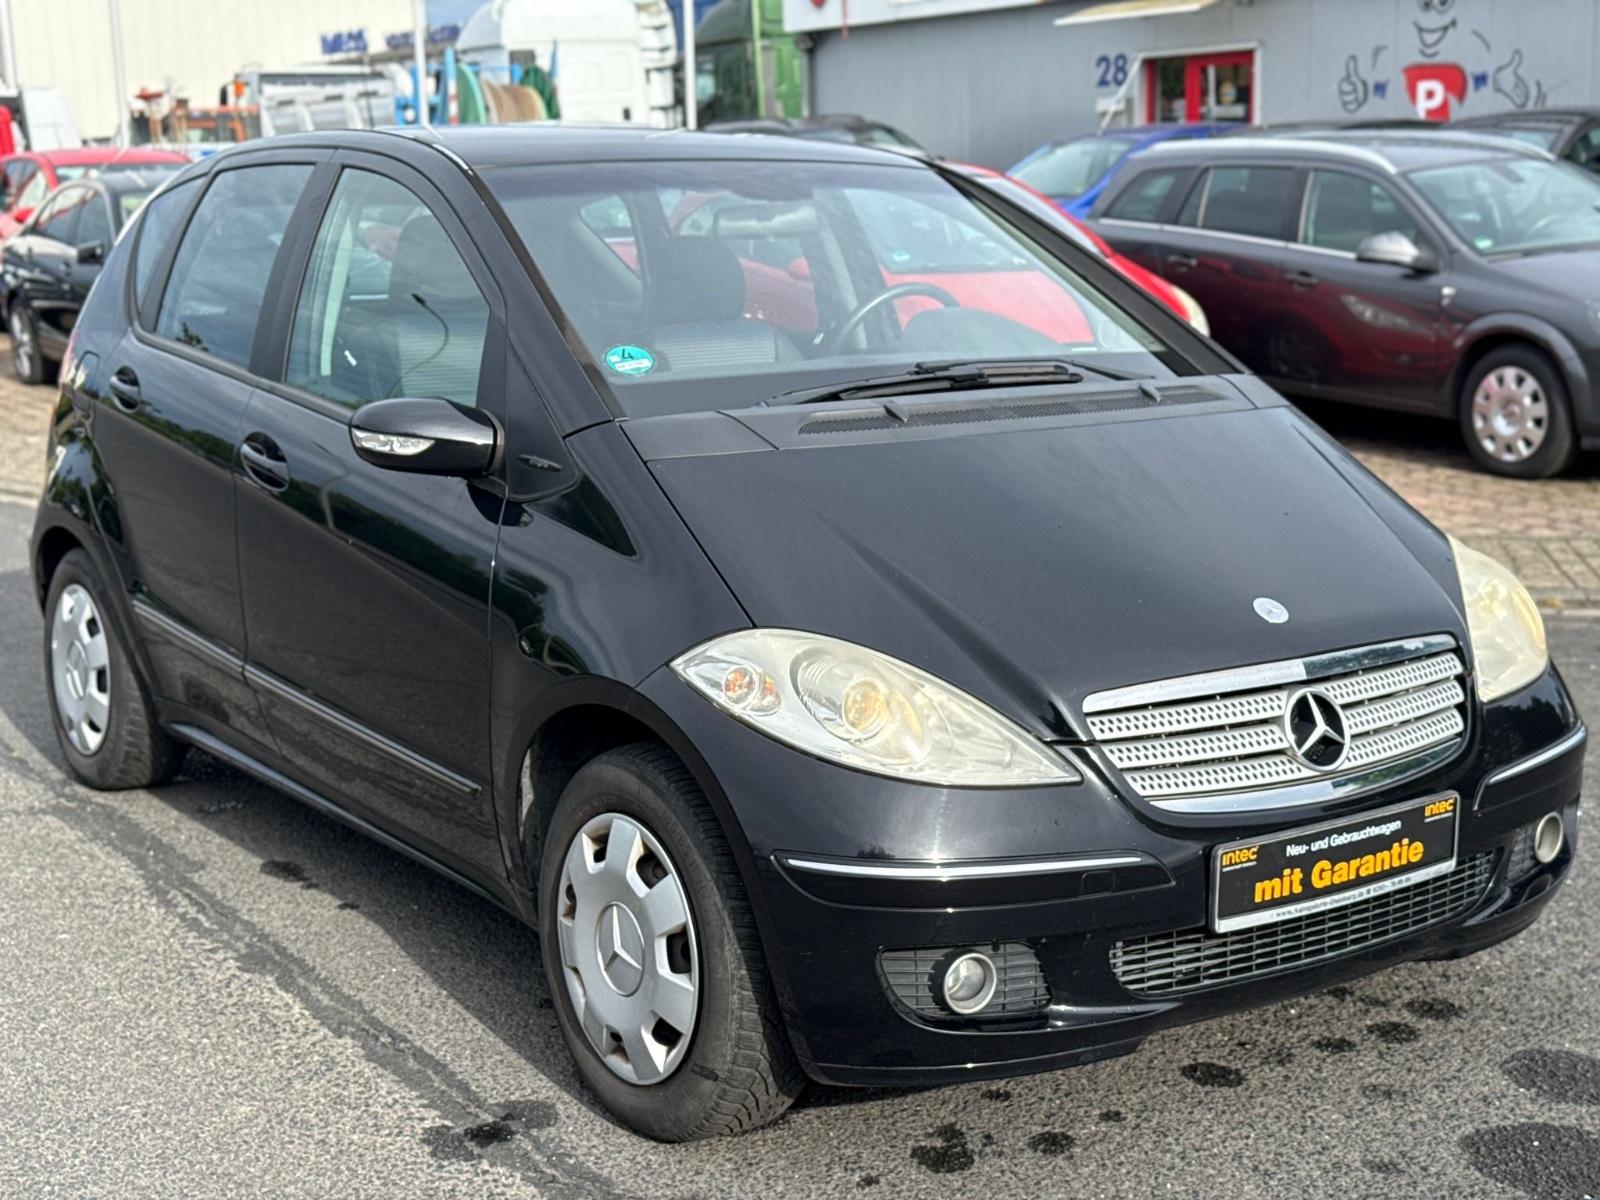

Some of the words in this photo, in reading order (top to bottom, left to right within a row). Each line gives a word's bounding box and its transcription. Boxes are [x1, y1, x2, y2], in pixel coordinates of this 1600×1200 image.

[1096, 54, 1128, 88] 28
[1415, 79, 1446, 120] P
[621, 348, 634, 360] 4
[1424, 798, 1455, 817] intec
[1286, 844, 1309, 857] Neu-
[1310, 836, 1329, 852] und
[1330, 820, 1402, 847] Gebrauchtwagen
[1222, 847, 1258, 866] intec
[1254, 867, 1303, 903] mit
[1311, 838, 1424, 889] Garantie
